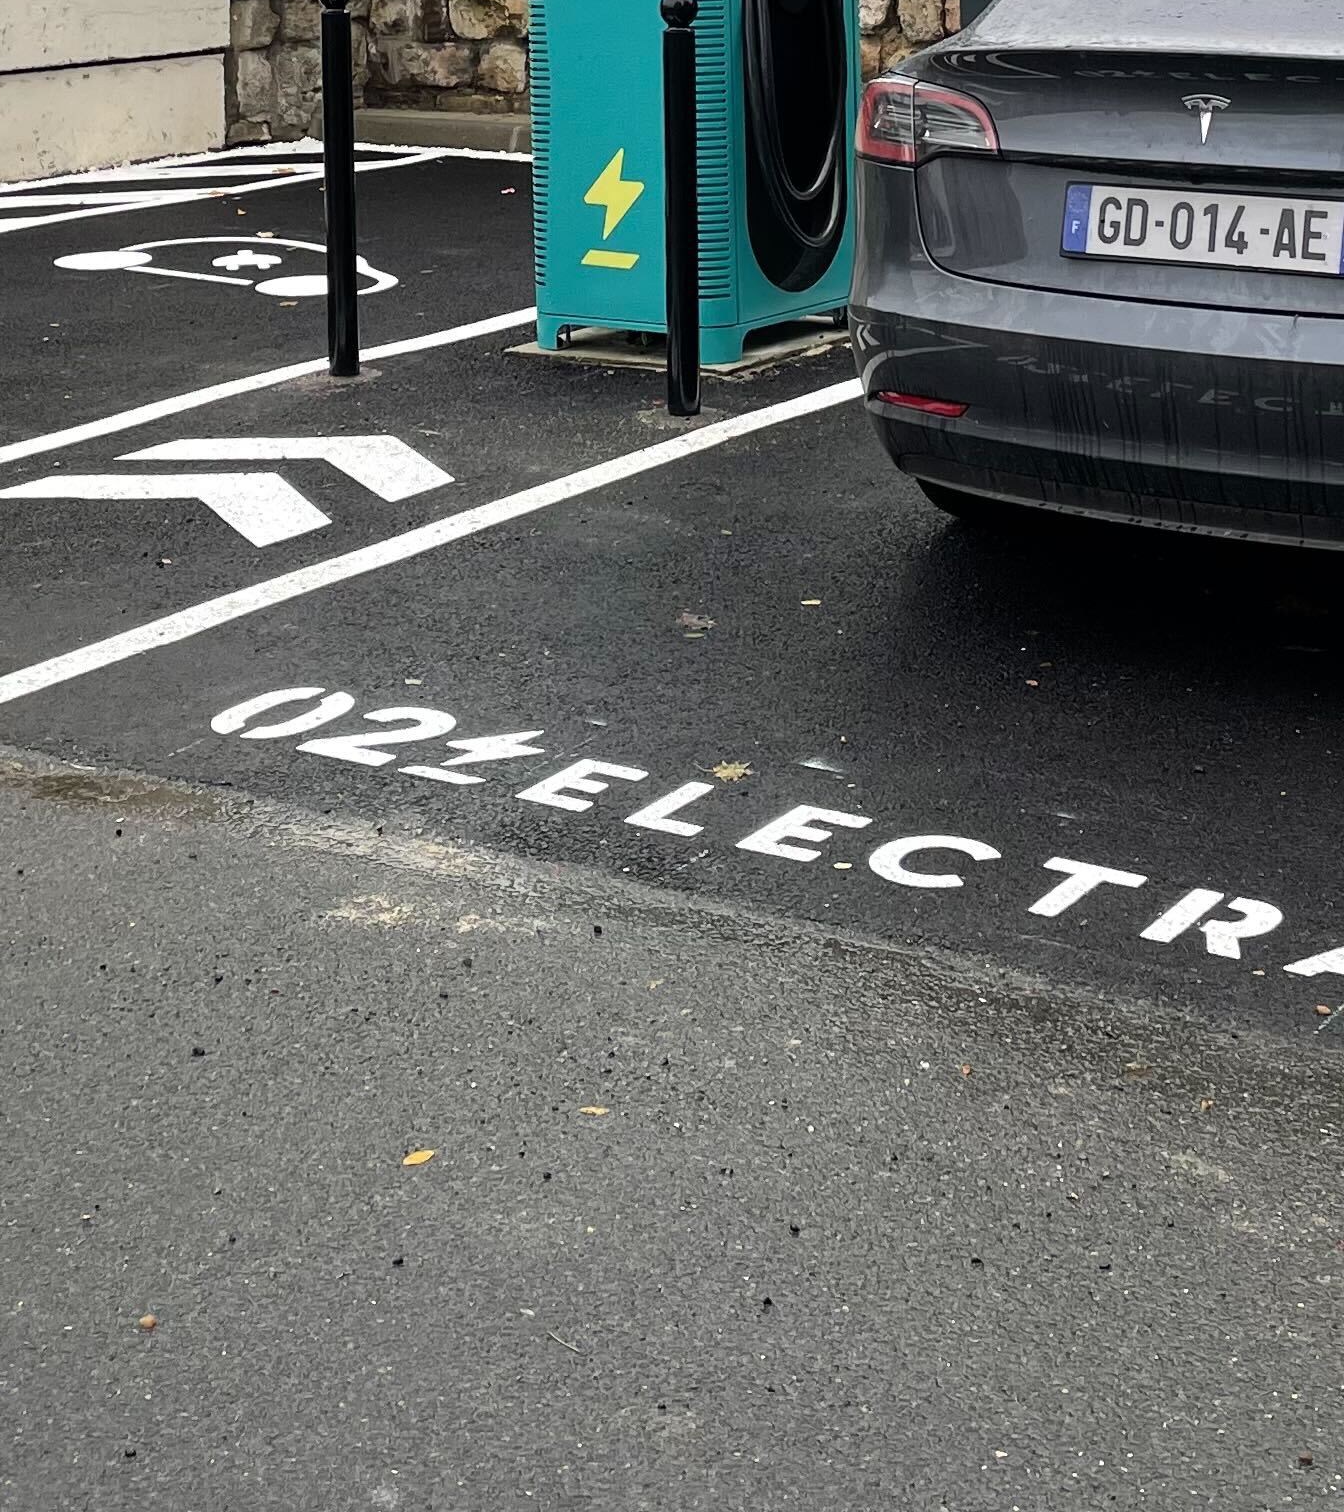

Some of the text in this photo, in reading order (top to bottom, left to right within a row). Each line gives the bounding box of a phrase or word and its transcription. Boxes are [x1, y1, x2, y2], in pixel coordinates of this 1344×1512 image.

[1071, 220, 1081, 234] F
[1098, 196, 1328, 261] GD-014-AE
[210, 686, 459, 768] 02
